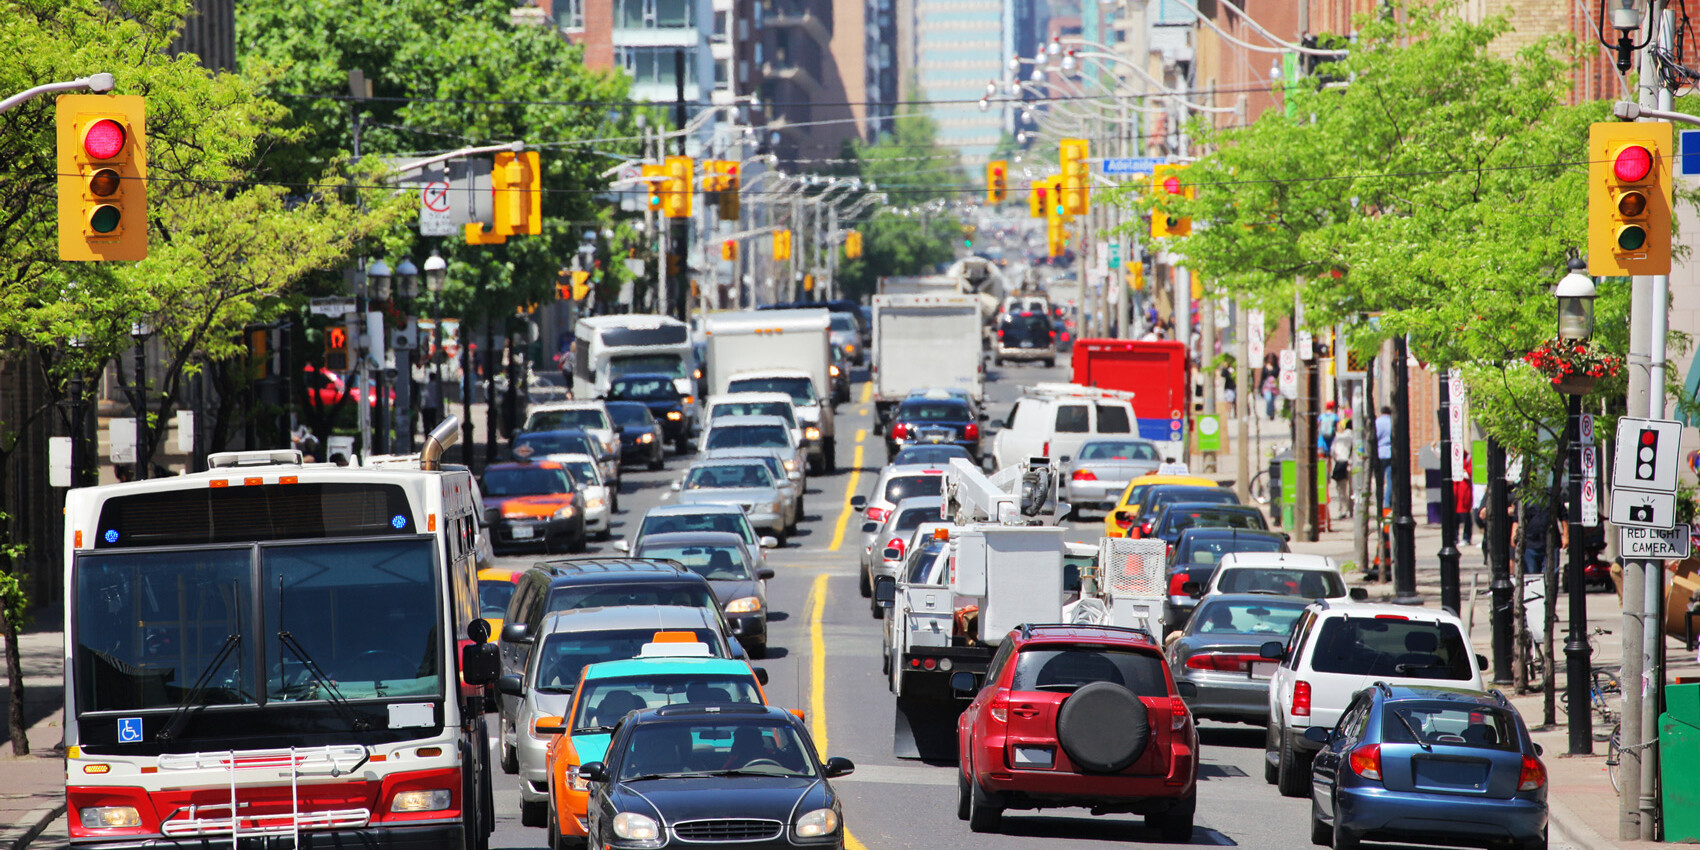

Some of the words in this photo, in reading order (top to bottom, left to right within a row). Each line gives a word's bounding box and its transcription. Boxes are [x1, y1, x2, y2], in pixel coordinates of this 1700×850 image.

[1627, 528, 1646, 539] RED
[1650, 528, 1681, 539] LIGHT
[1632, 542, 1676, 553] CAMERA
